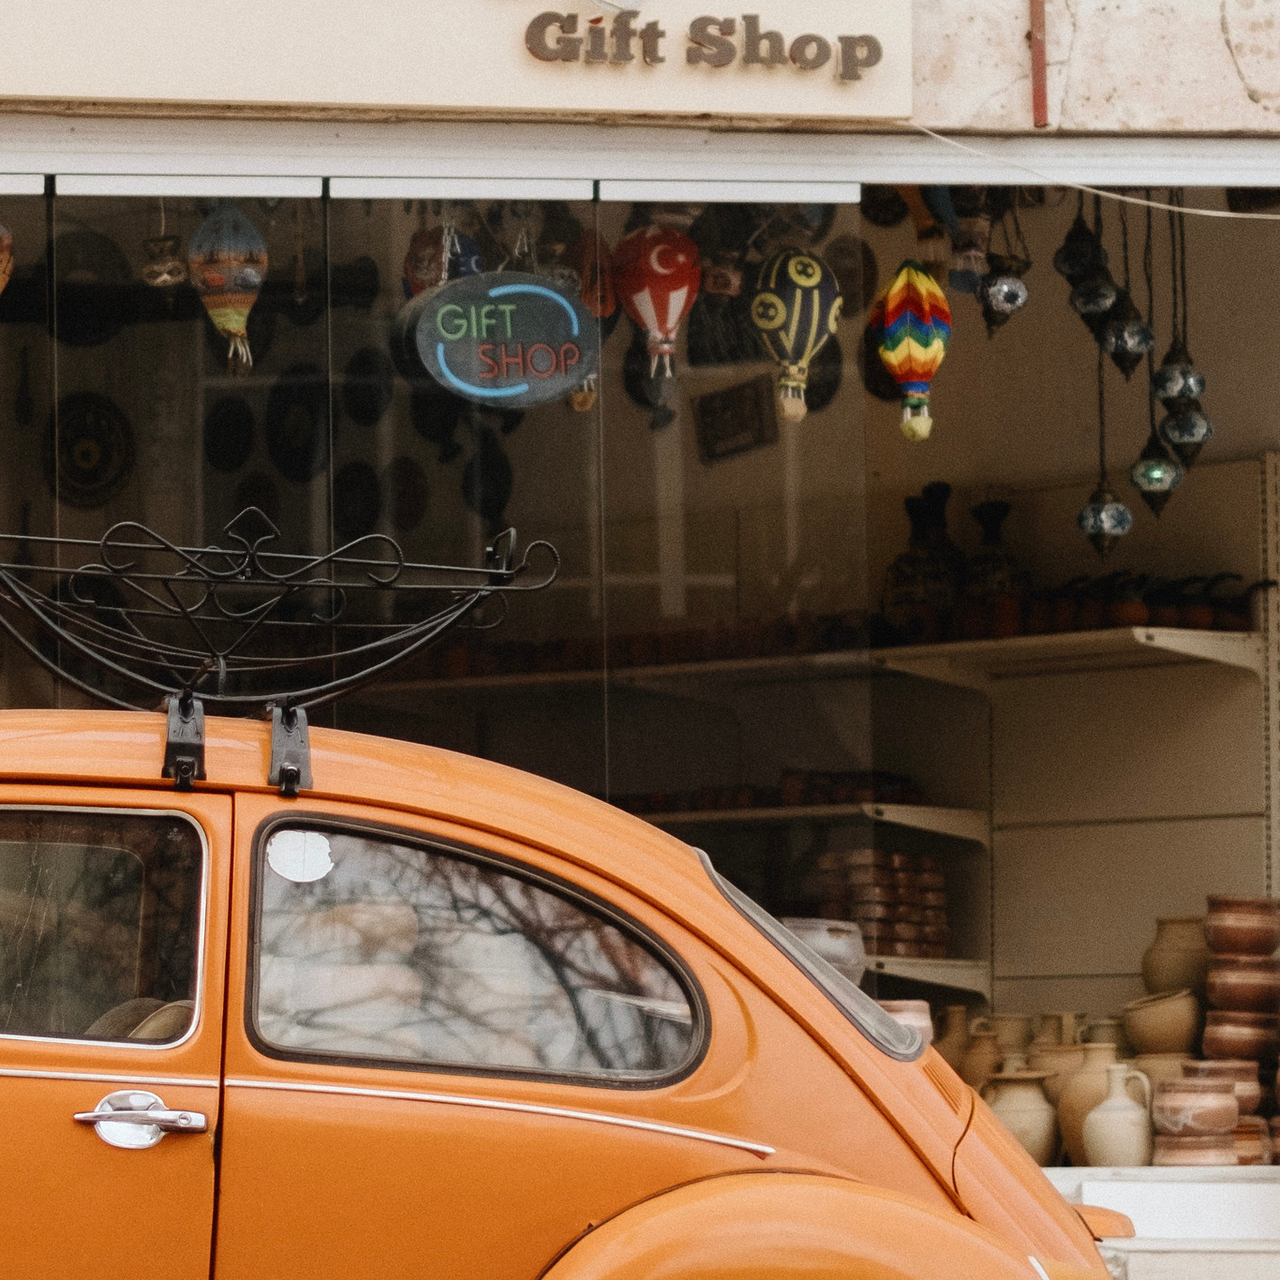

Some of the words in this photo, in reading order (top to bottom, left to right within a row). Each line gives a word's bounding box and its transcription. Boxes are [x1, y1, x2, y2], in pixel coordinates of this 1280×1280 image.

[525, 10, 666, 65] Gift
[686, 14, 883, 81] Shop
[436, 303, 517, 341] GIFT
[477, 342, 581, 379] SHOP
